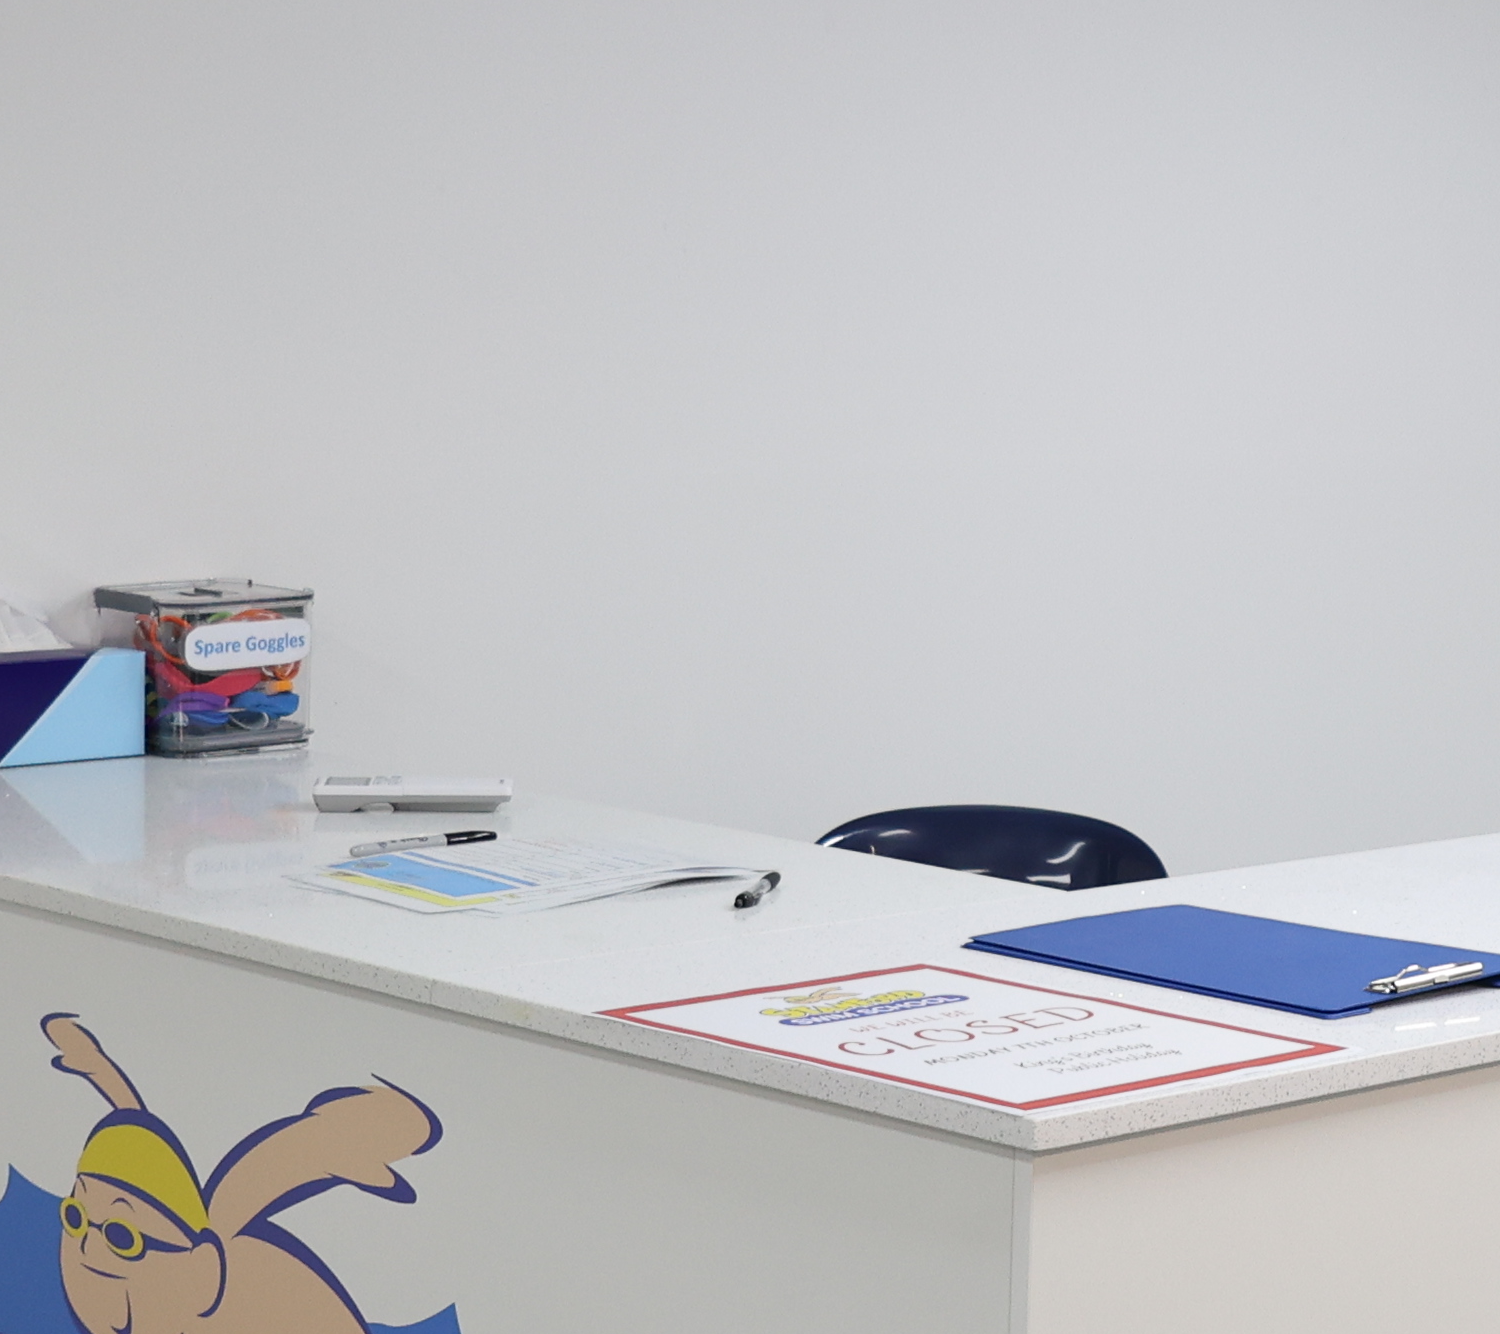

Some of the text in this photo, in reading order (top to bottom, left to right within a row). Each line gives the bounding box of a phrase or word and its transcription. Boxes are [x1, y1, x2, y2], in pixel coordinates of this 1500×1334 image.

[194, 632, 305, 658] Spare Goggles
[858, 995, 962, 1015] SCHOOL
[838, 1006, 1094, 1056] CLOSED
[924, 1046, 1011, 1066] MONDAY
[1054, 1023, 1150, 1043] OCTOBER
